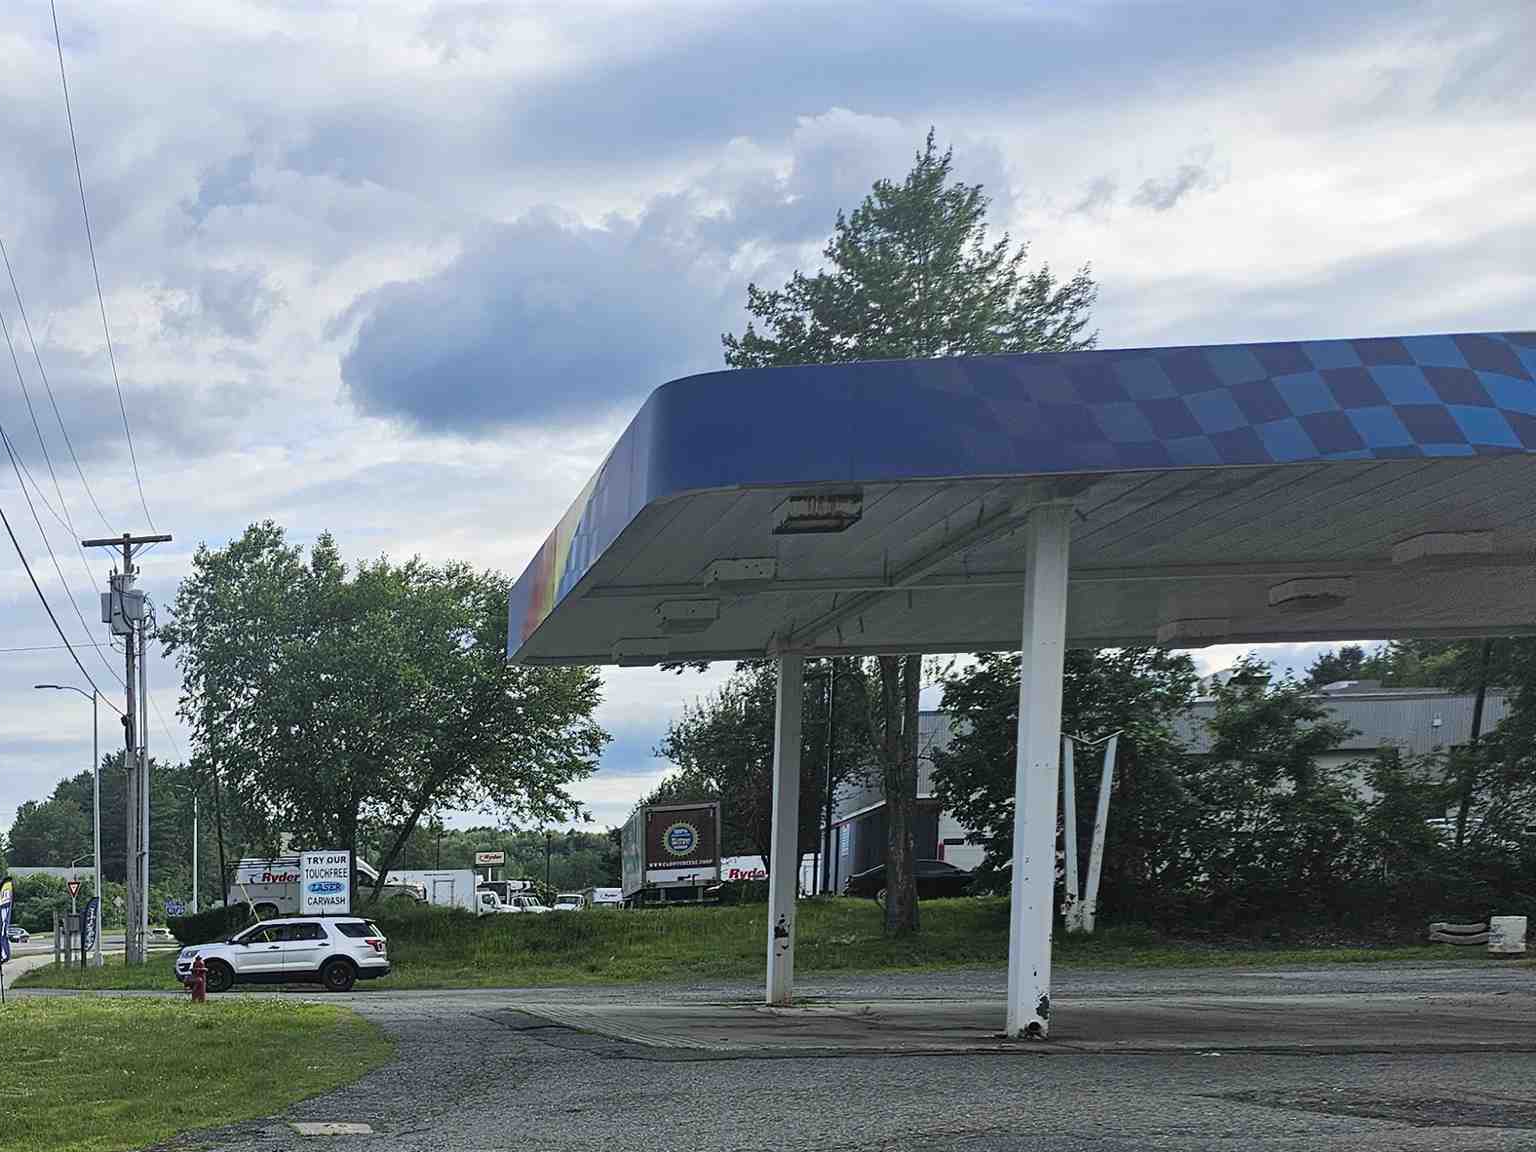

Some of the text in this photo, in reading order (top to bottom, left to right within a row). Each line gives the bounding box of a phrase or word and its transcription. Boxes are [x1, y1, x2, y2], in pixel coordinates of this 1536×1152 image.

[307, 856, 347, 865] TRY OUR
[262, 871, 301, 883] Ryder
[305, 868, 348, 880] TOUCHFREE
[311, 883, 343, 893] LASER
[307, 897, 346, 906] CARWASH
